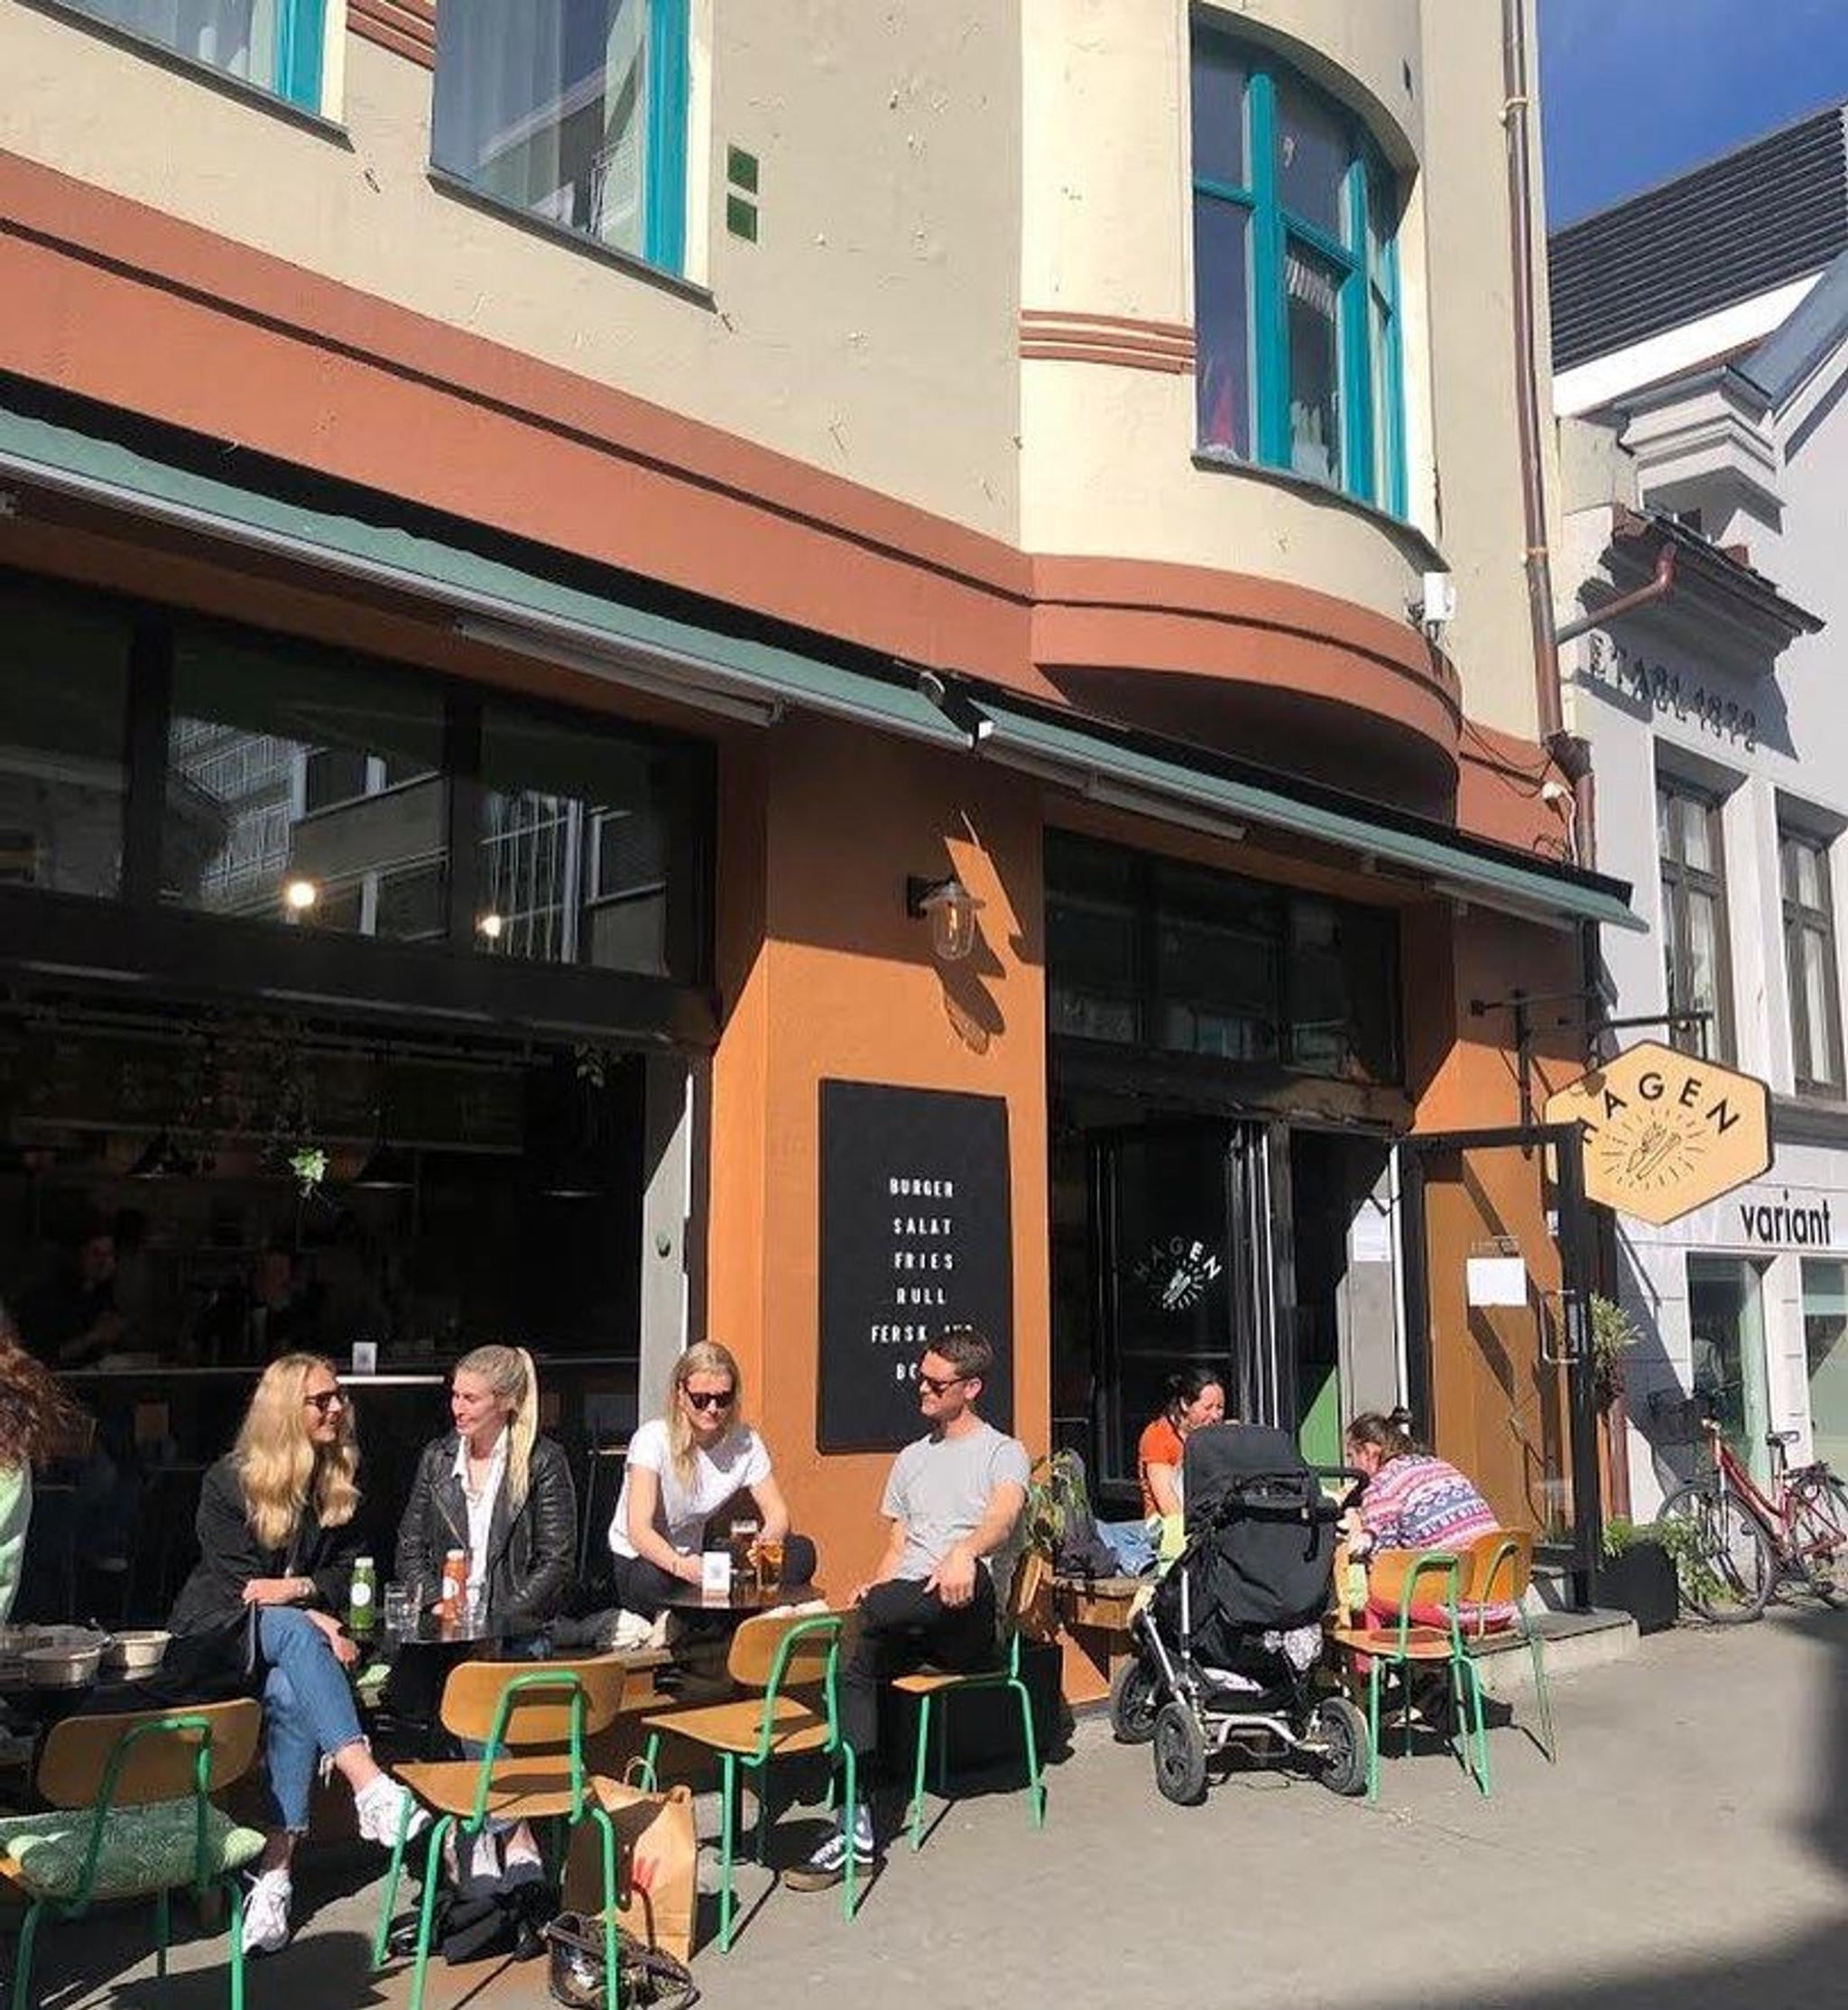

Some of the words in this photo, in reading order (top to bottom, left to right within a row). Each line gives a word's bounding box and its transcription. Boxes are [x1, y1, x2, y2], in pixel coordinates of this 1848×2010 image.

[889, 1177, 953, 1199] BURGER
[893, 1218, 951, 1235] SALAT
[1740, 1189, 1830, 1245] variant
[894, 1251, 953, 1270] FRIES
[896, 1287, 946, 1305] RULL
[871, 1324, 928, 1343] FERSK
